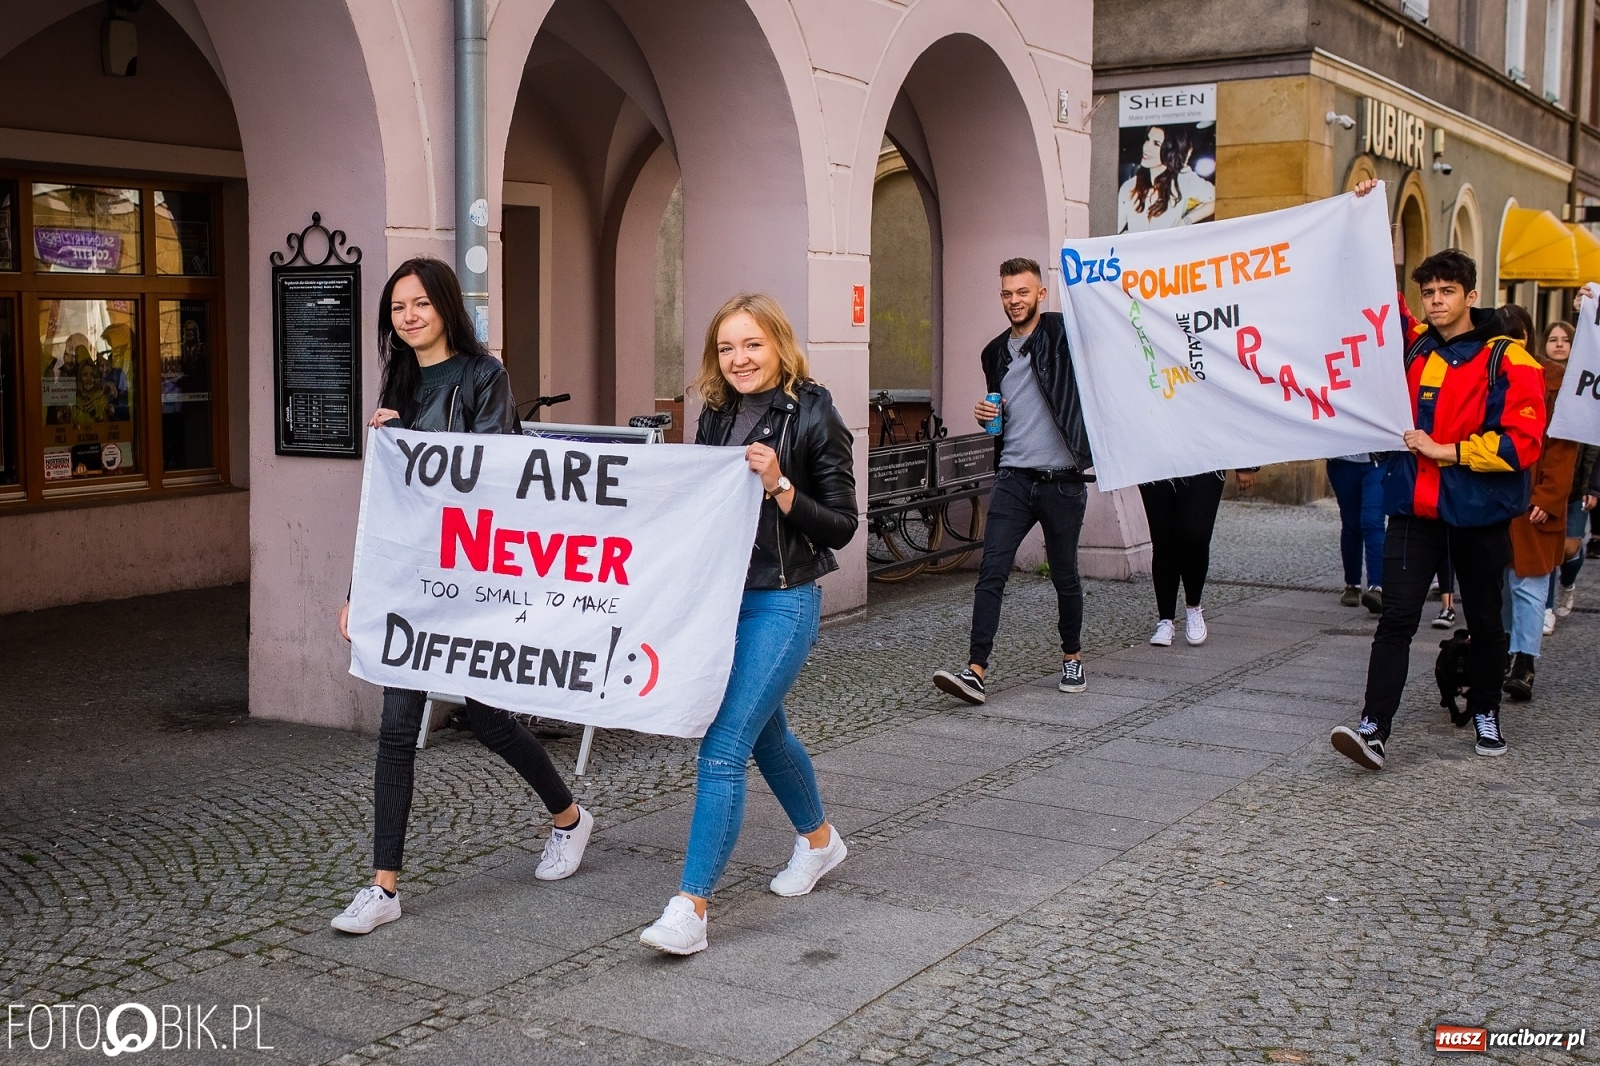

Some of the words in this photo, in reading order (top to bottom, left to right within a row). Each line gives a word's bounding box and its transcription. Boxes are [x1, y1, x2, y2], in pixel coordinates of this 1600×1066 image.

[1129, 93, 1204, 110] SHEEN
[1122, 242, 1290, 300] POWIETRZE
[1194, 304, 1240, 334] DNI
[1176, 313, 1206, 380] OSTATNIE
[1236, 304, 1390, 420] PLANETY
[1160, 366, 1196, 400] JAK
[396, 438, 484, 494] YOU
[515, 448, 628, 507] ARE
[440, 506, 633, 586] NEVER
[420, 578, 460, 599] TOO
[475, 586, 533, 607] SMALL
[545, 592, 565, 608] TO
[573, 595, 620, 615] MAKE
[515, 610, 528, 624] A
